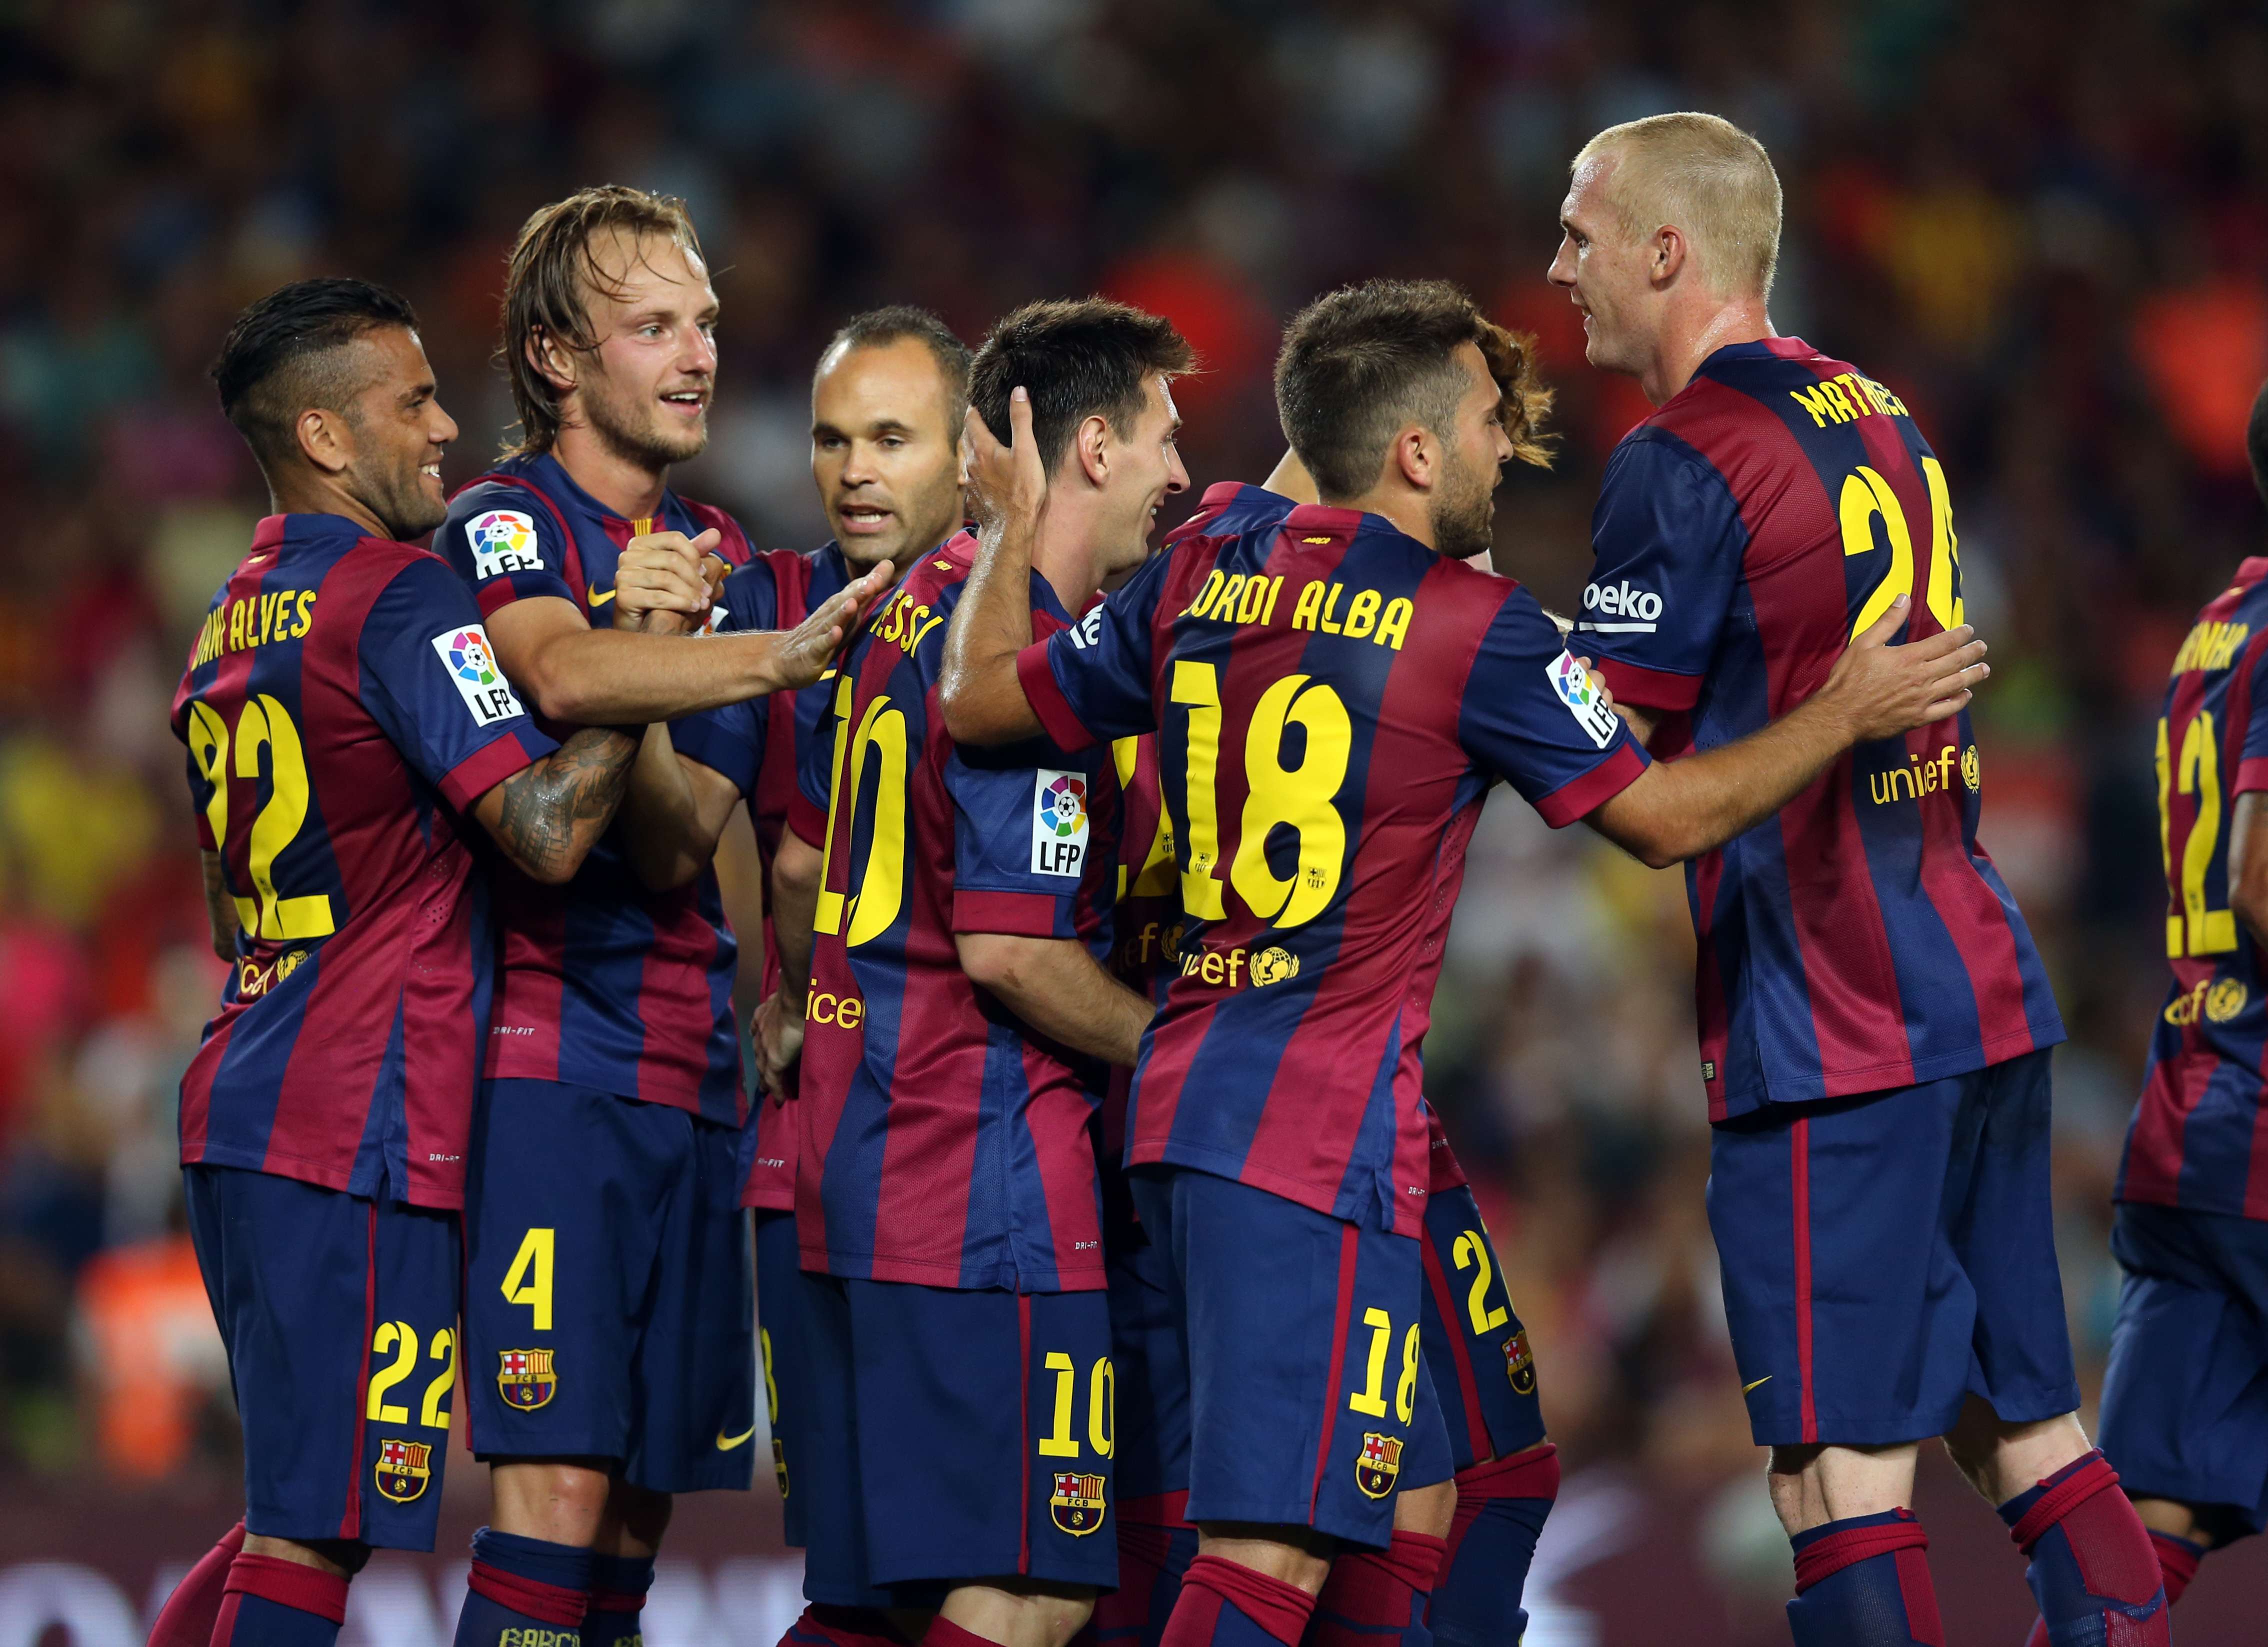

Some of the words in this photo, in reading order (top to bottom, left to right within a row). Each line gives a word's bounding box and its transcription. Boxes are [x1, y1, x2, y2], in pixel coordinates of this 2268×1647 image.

[230, 590, 317, 652] ALVES
[870, 589, 944, 658] ESSI
[1292, 580, 1414, 650] ALBA
[474, 688, 512, 720] LFP
[188, 694, 336, 940] 22
[813, 675, 906, 948] 10
[1170, 660, 1352, 928] 18
[1040, 841, 1080, 874] LFP
[805, 978, 866, 1032] ice
[500, 1228, 555, 1330] 4
[1452, 1218, 1513, 1336] 2
[366, 1320, 457, 1429] 22
[516, 1374, 538, 1382] FCB
[1349, 1306, 1420, 1427] 18
[1038, 1352, 1114, 1460] 10
[392, 1466, 413, 1476] FCB
[1372, 1460, 1388, 1471] FCB
[1068, 1498, 1088, 1507] FCB
